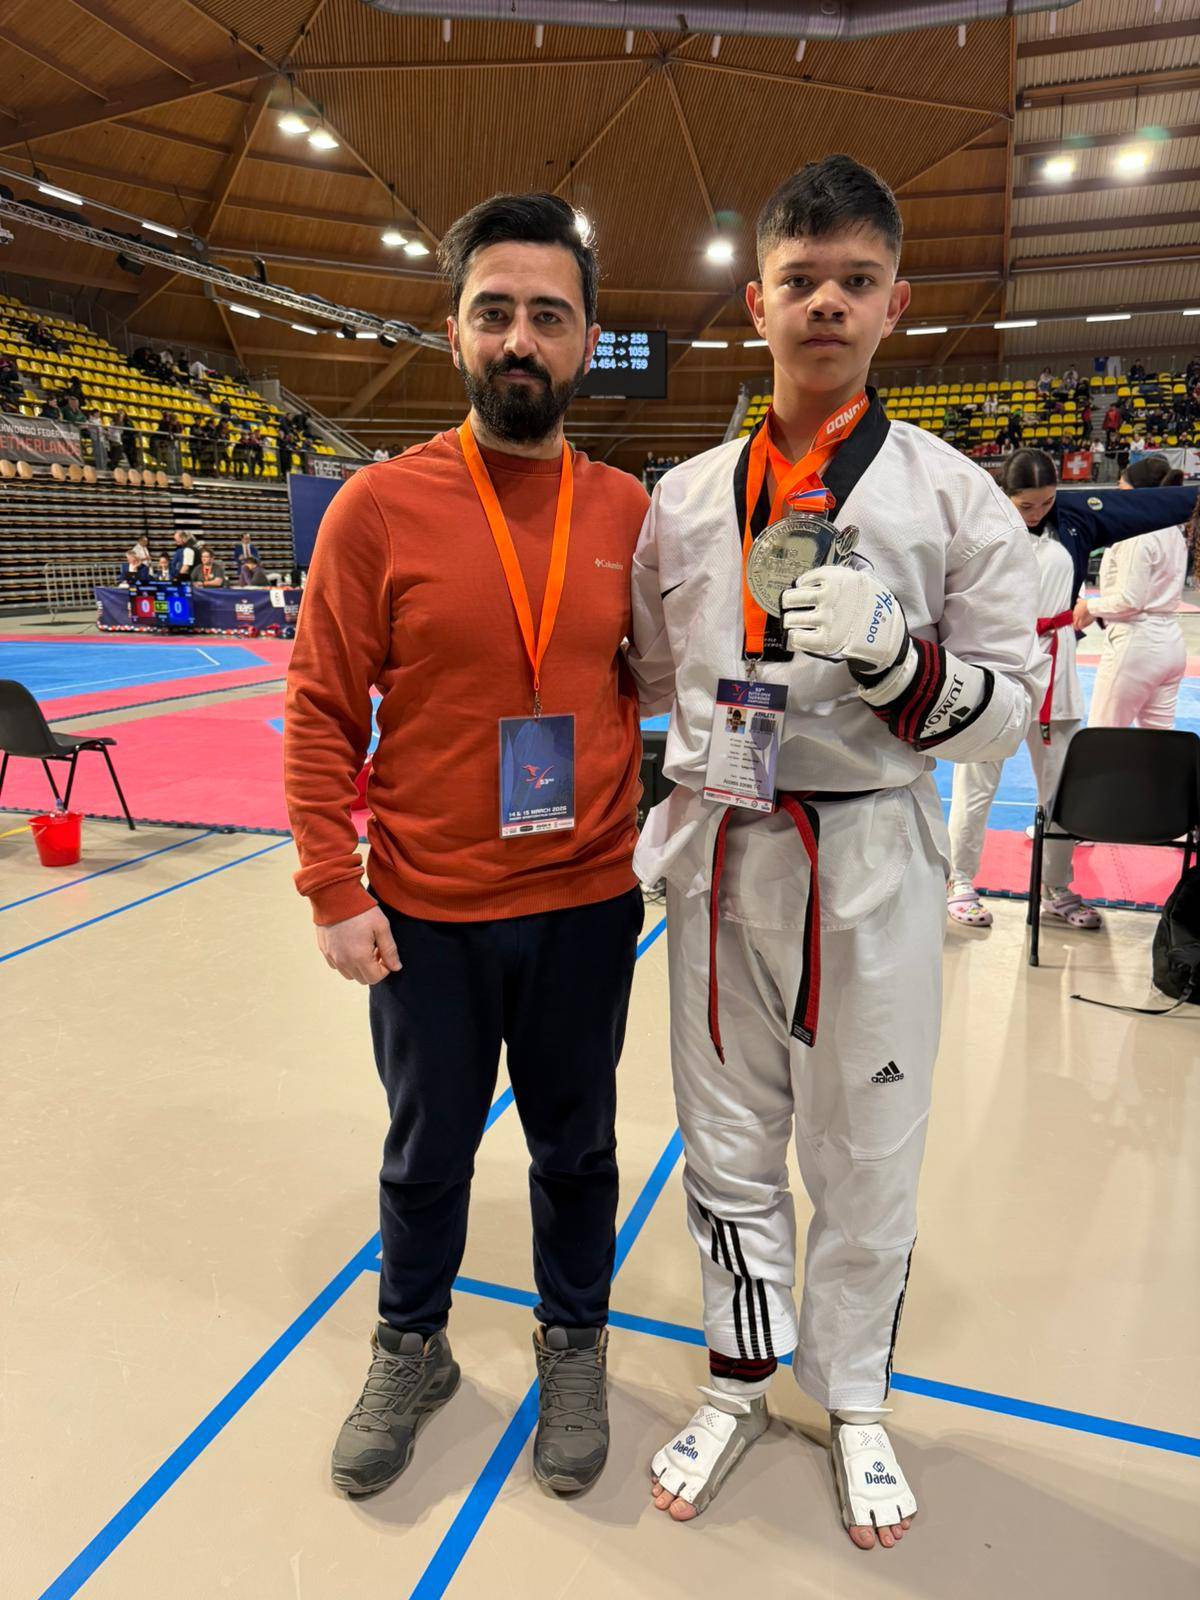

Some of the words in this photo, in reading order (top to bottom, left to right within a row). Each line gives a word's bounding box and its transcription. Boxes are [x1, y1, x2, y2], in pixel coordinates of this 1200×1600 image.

[630, 332, 648, 344] 258
[596, 345, 613, 356] 552
[628, 345, 650, 357] 1056
[598, 357, 616, 369] 454
[630, 358, 648, 369] 759
[141, 599, 150, 613] 0
[174, 601, 182, 614] 0
[530, 807, 551, 815] MARCH
[871, 1073, 904, 1084] adidas
[672, 1440, 699, 1461] Daedo
[864, 1471, 897, 1485] Daedo
